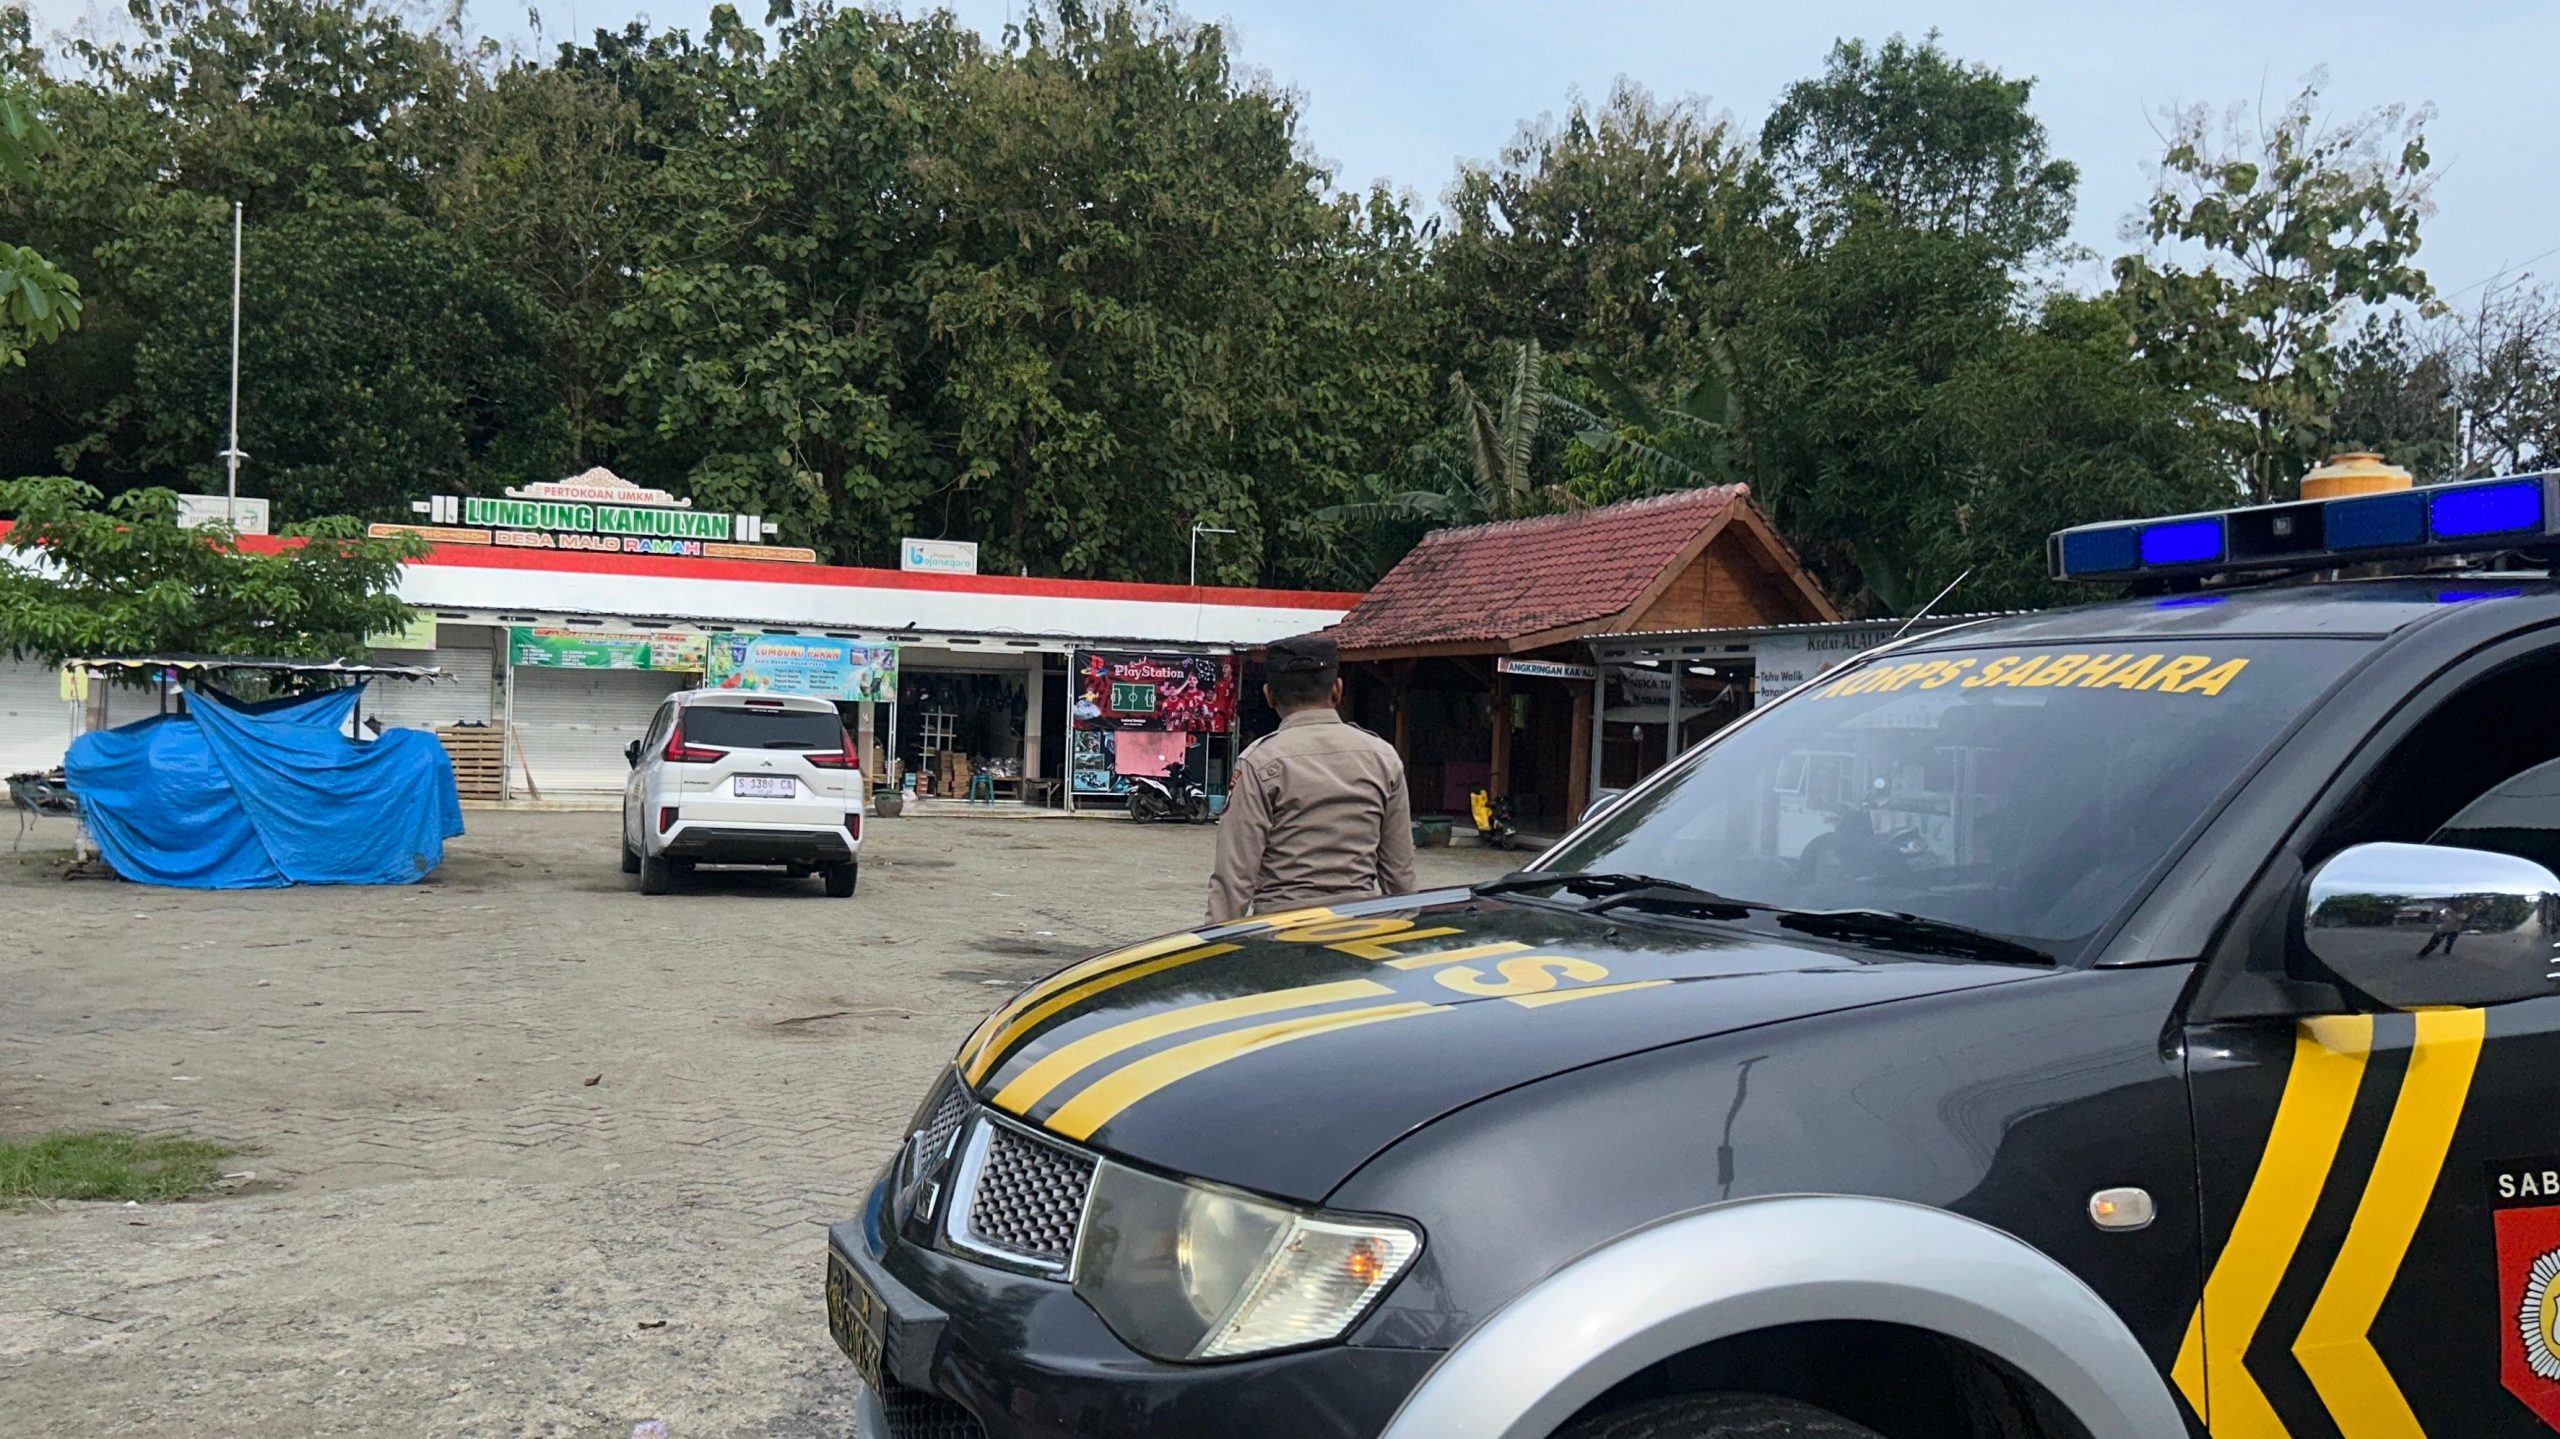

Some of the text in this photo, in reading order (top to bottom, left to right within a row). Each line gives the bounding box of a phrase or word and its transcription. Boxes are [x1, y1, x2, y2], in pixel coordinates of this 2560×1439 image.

[543, 486, 655, 502] PERTOKOAN UMKM
[466, 497, 730, 540] LUMBUNG KAMULYAN
[497, 530, 700, 556] DESA MALO RAMAH
[1808, 634, 1839, 651] Kedai
[756, 646, 841, 660] LUMBUNG PAKAN
[1114, 664, 1185, 680] PlayStation
[1509, 661, 1563, 676] ANGKRINGAN
[1781, 670, 1803, 681] Walik
[1811, 653, 2250, 701] KORPS SABHARA
[738, 778, 745, 789] S
[781, 779, 793, 790] CA
